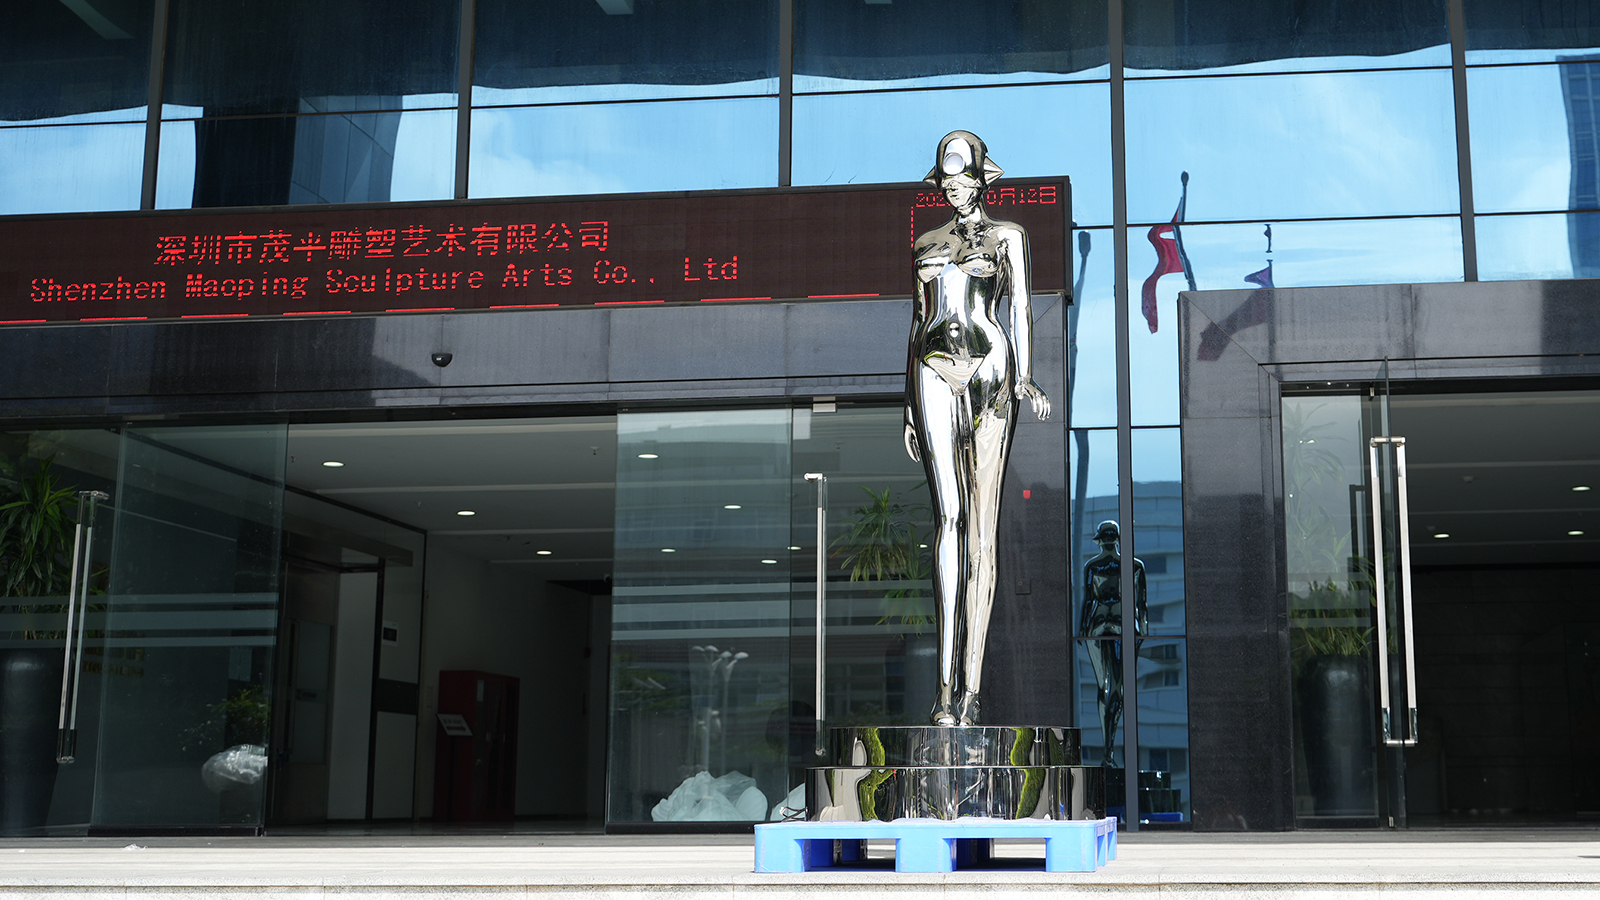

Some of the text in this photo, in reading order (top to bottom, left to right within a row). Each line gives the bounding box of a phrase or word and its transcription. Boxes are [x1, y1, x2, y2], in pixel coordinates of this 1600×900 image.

[30, 275, 167, 303] Shenzhen
[185, 271, 309, 301] Maoping
[325, 267, 485, 296] Sculpture
[501, 263, 573, 288] Arts
[684, 255, 739, 282] Ltd
